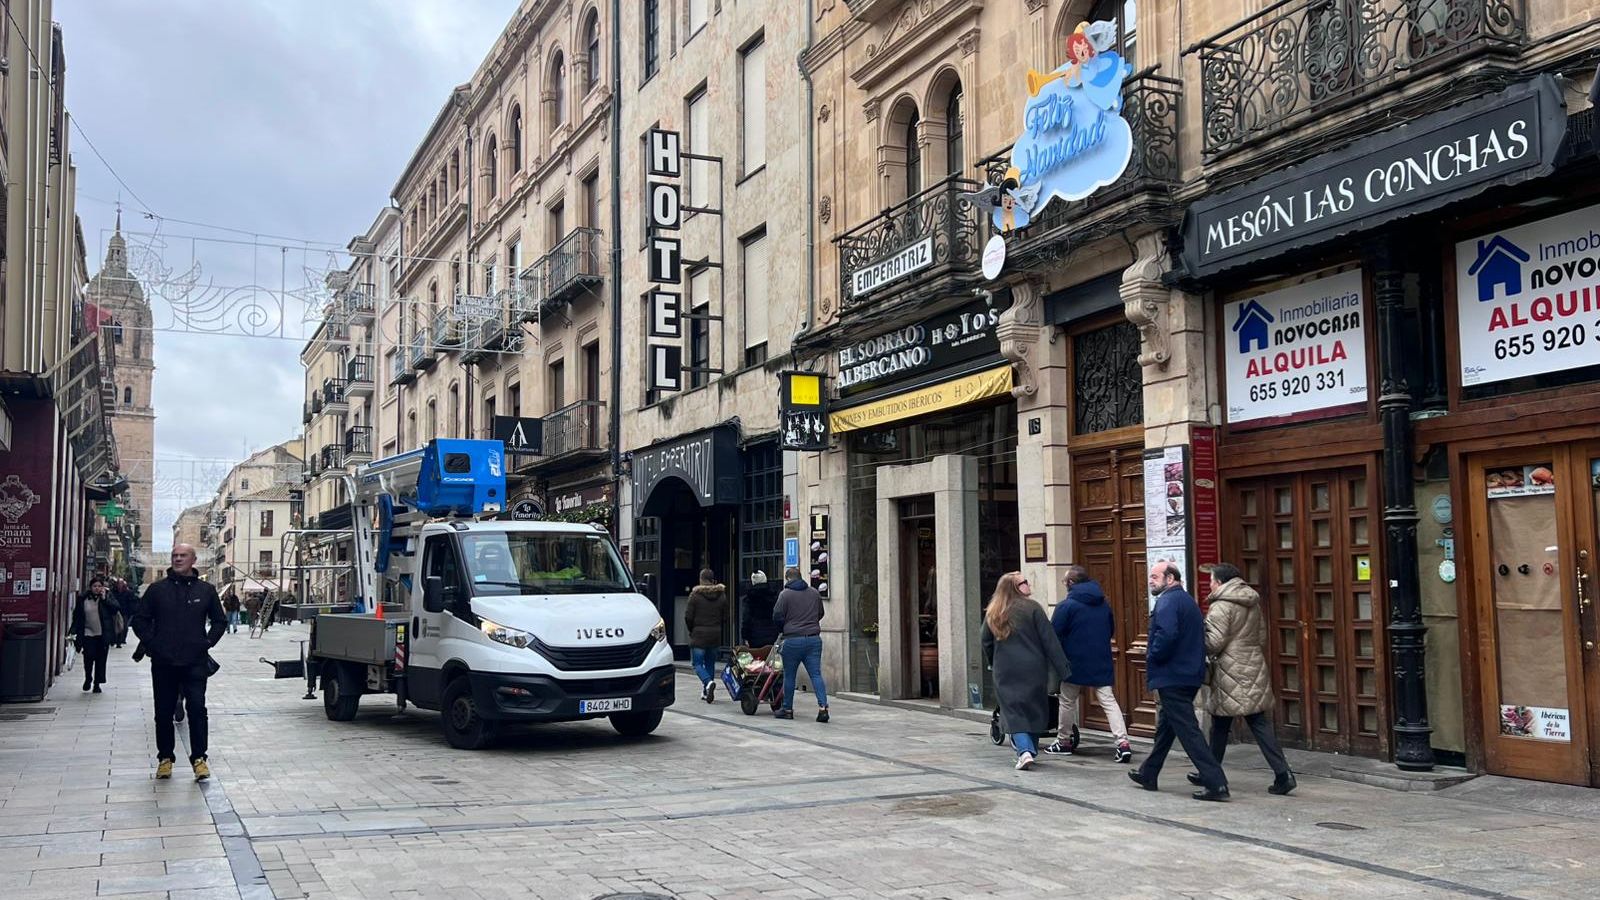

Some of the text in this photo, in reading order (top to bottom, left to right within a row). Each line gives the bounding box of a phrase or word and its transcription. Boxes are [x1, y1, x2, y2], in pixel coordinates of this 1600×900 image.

[1025, 93, 1073, 140] Feliz
[1020, 110, 1106, 184] Navidad
[1204, 119, 1529, 254] MESÓN LAS CONCHAS
[652, 132, 678, 388] HOTEL
[1539, 230, 1600, 262] Inmob
[857, 243, 927, 292] EMPERATRIZ
[1530, 256, 1600, 290] NOVO
[1279, 291, 1360, 324] Inmobiliaria
[1488, 285, 1600, 332] ALQUI
[839, 347, 856, 367] EL
[858, 325, 923, 361] SOBRAO
[1245, 340, 1347, 379] ALQUILA
[1494, 333, 1535, 360] 655
[1542, 323, 1586, 352] 920
[836, 346, 927, 389] ALBERCANO
[1249, 368, 1345, 402] 655 920 331
[868, 400, 908, 420] EMBUTIDOS
[908, 391, 943, 410] IBÉRICOS
[1029, 418, 1041, 434] 16
[577, 628, 625, 640] IVECO
[586, 700, 610, 712] 8402
